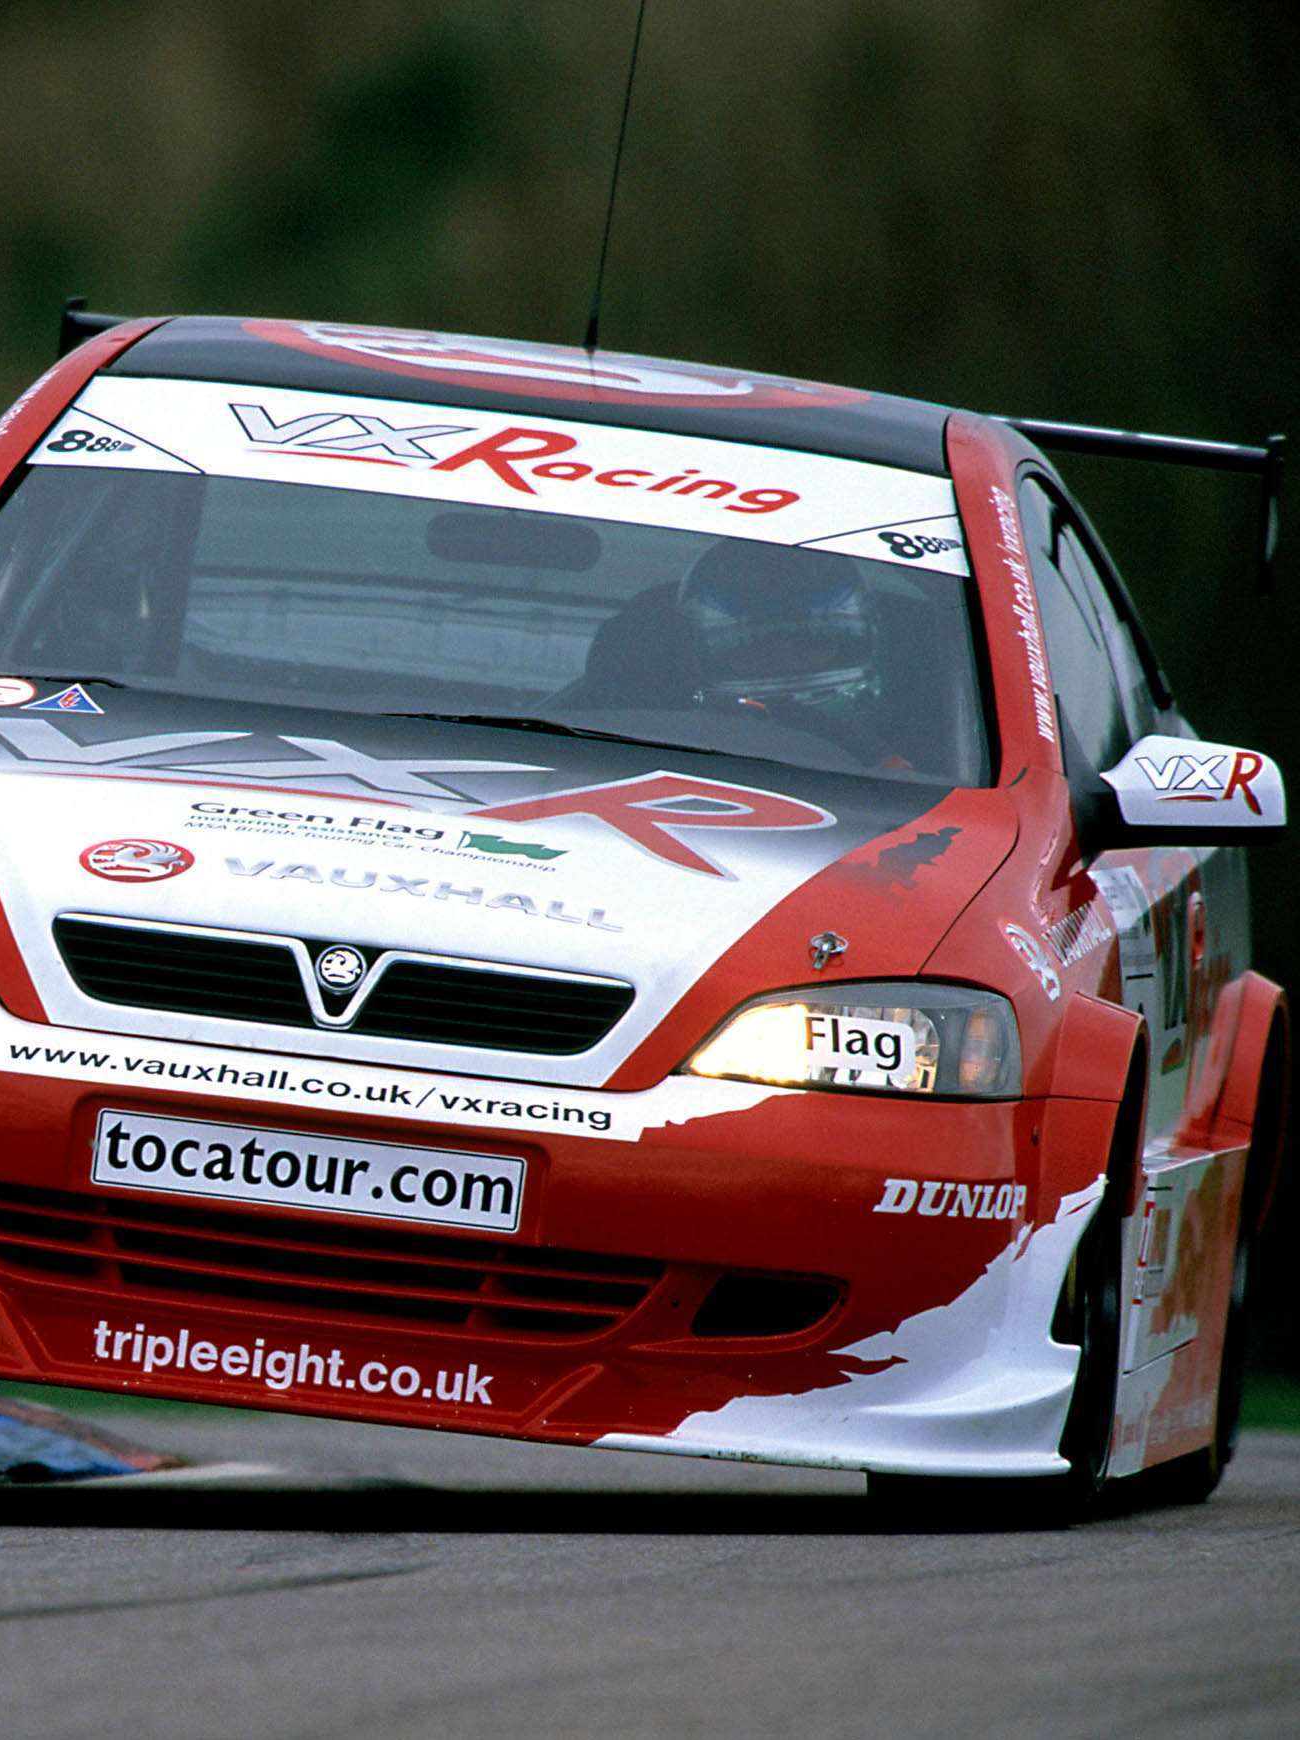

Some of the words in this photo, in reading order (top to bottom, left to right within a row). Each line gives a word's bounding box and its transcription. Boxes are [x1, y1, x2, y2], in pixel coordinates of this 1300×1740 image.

[1135, 751, 1263, 816] VXR
[184, 821, 228, 831] MSA
[235, 825, 297, 838] British
[304, 832, 376, 846] Touring
[382, 841, 416, 850] Car
[420, 845, 557, 873] Championship
[189, 814, 290, 830] motoring
[297, 824, 404, 841] assistance
[190, 802, 334, 825] Green
[349, 816, 445, 841] Flag
[224, 857, 624, 933] VAUXHALL
[805, 1016, 903, 1071] Flag
[9, 1044, 612, 1131] www.vauxhall.co.uk/vxracing
[106, 1120, 514, 1215] tocatour.com
[872, 1178, 1027, 1220] DUNLOP
[94, 1319, 495, 1406] tripleeight.co.uk
